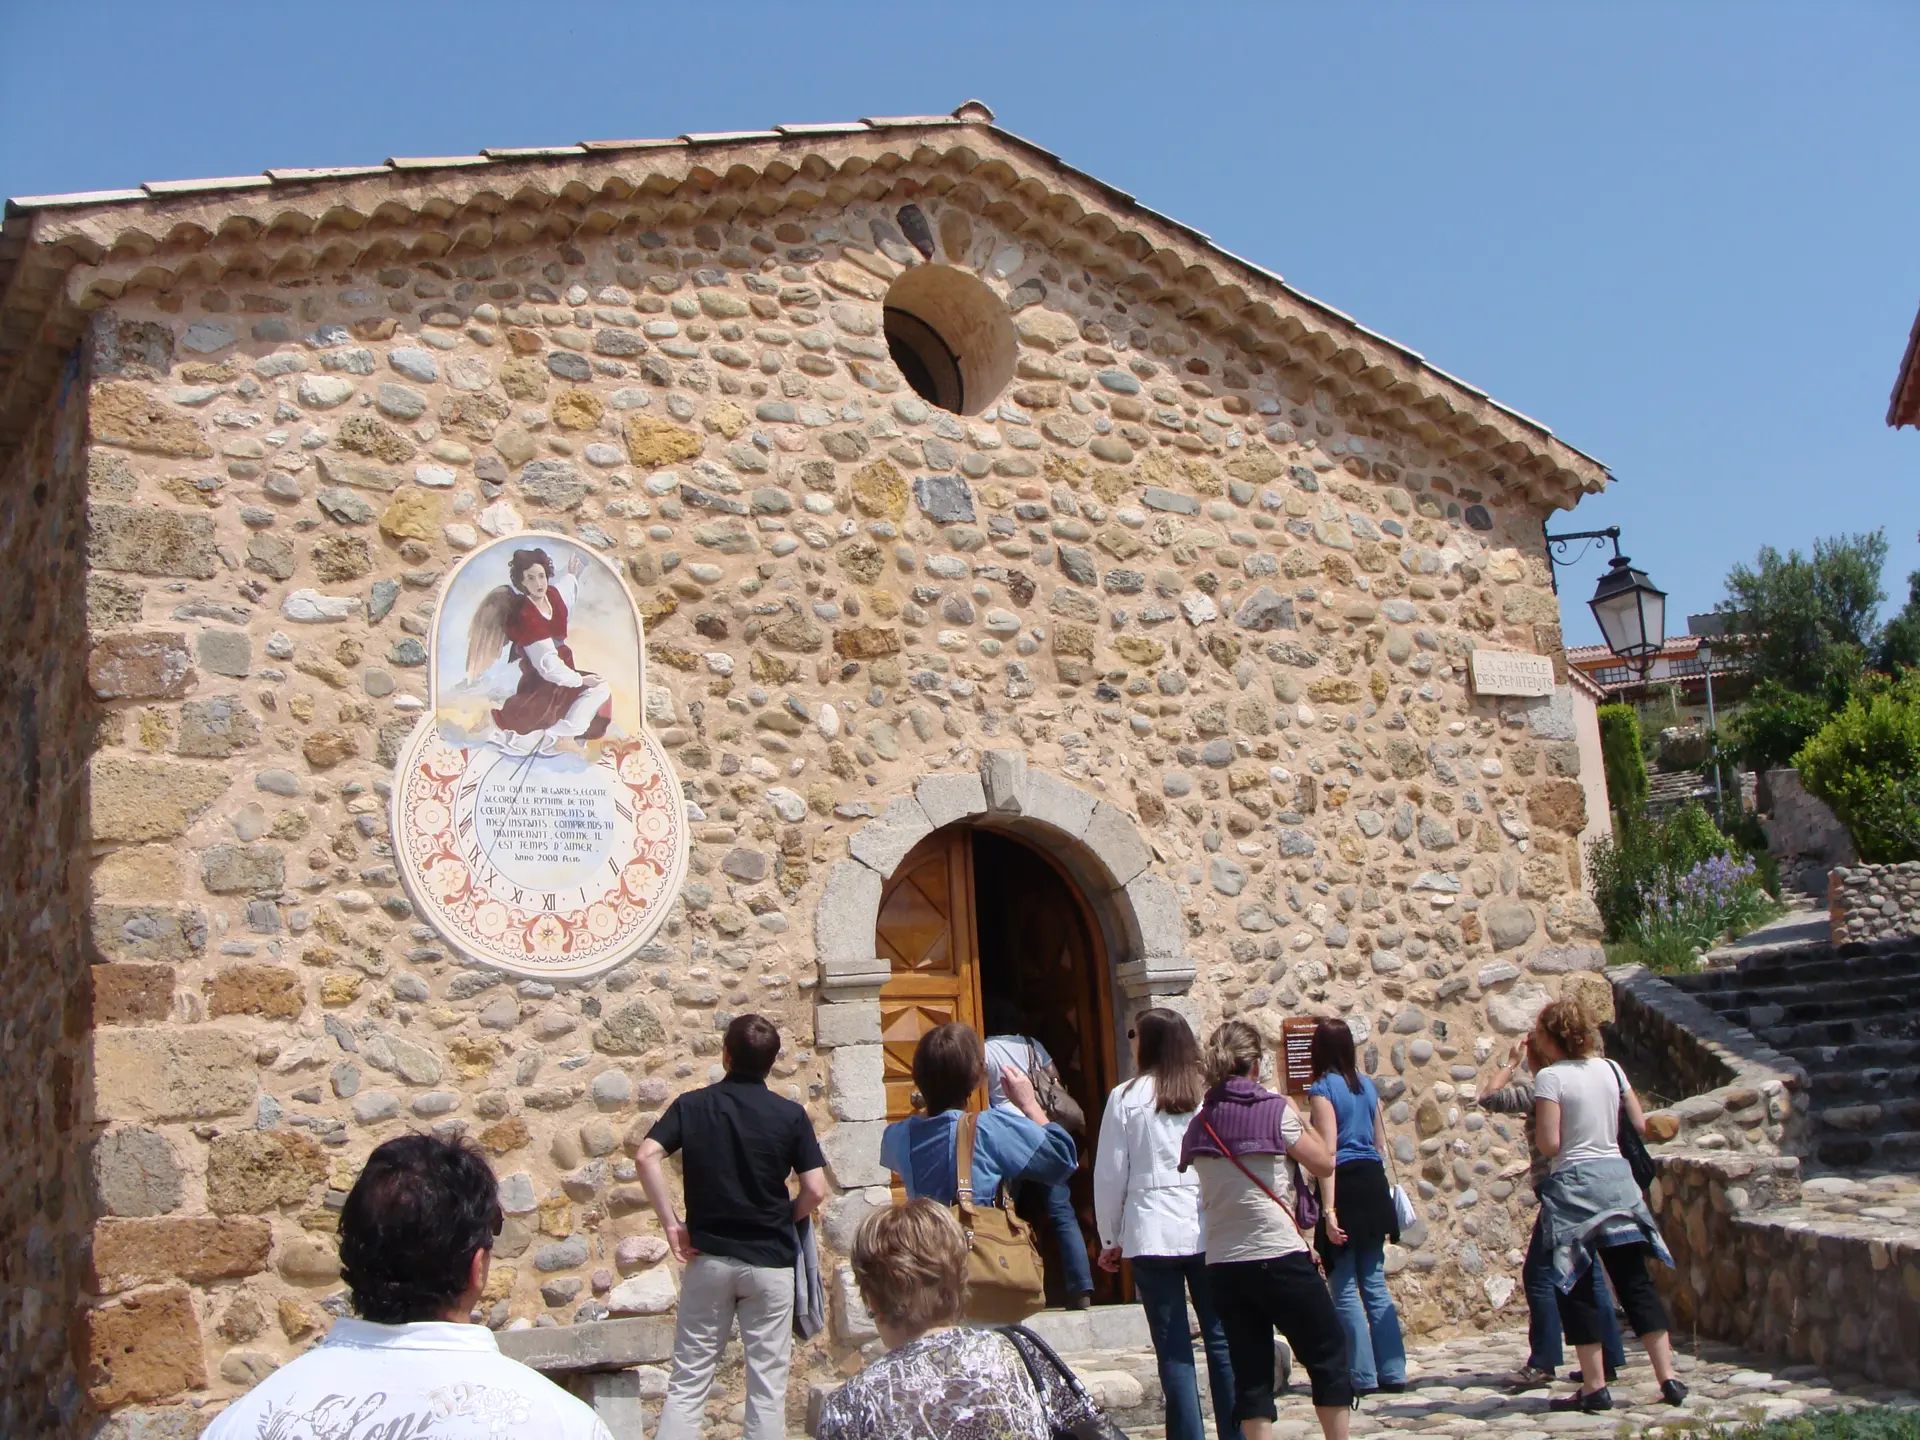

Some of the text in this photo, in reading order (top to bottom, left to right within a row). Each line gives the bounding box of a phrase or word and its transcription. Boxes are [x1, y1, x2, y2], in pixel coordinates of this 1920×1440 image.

[1497, 660, 1549, 675] CHAPELLE
[1476, 673, 1554, 690] DES PENITENTS
[492, 784, 506, 793] TOI
[509, 785, 523, 794] QUI
[526, 786, 537, 794] ME
[484, 795, 595, 807] ACCORDE LE RYTHME DE TON
[511, 807, 528, 816] AUX
[531, 807, 585, 818] BATTEMENTS
[588, 809, 598, 818] DE
[486, 818, 505, 827] MES
[554, 831, 589, 840] COMME
[594, 832, 603, 841] IL
[498, 841, 513, 850] EST
[520, 841, 549, 851] TEMPS
[537, 854, 559, 862] 2000
[541, 893, 556, 911] XII
